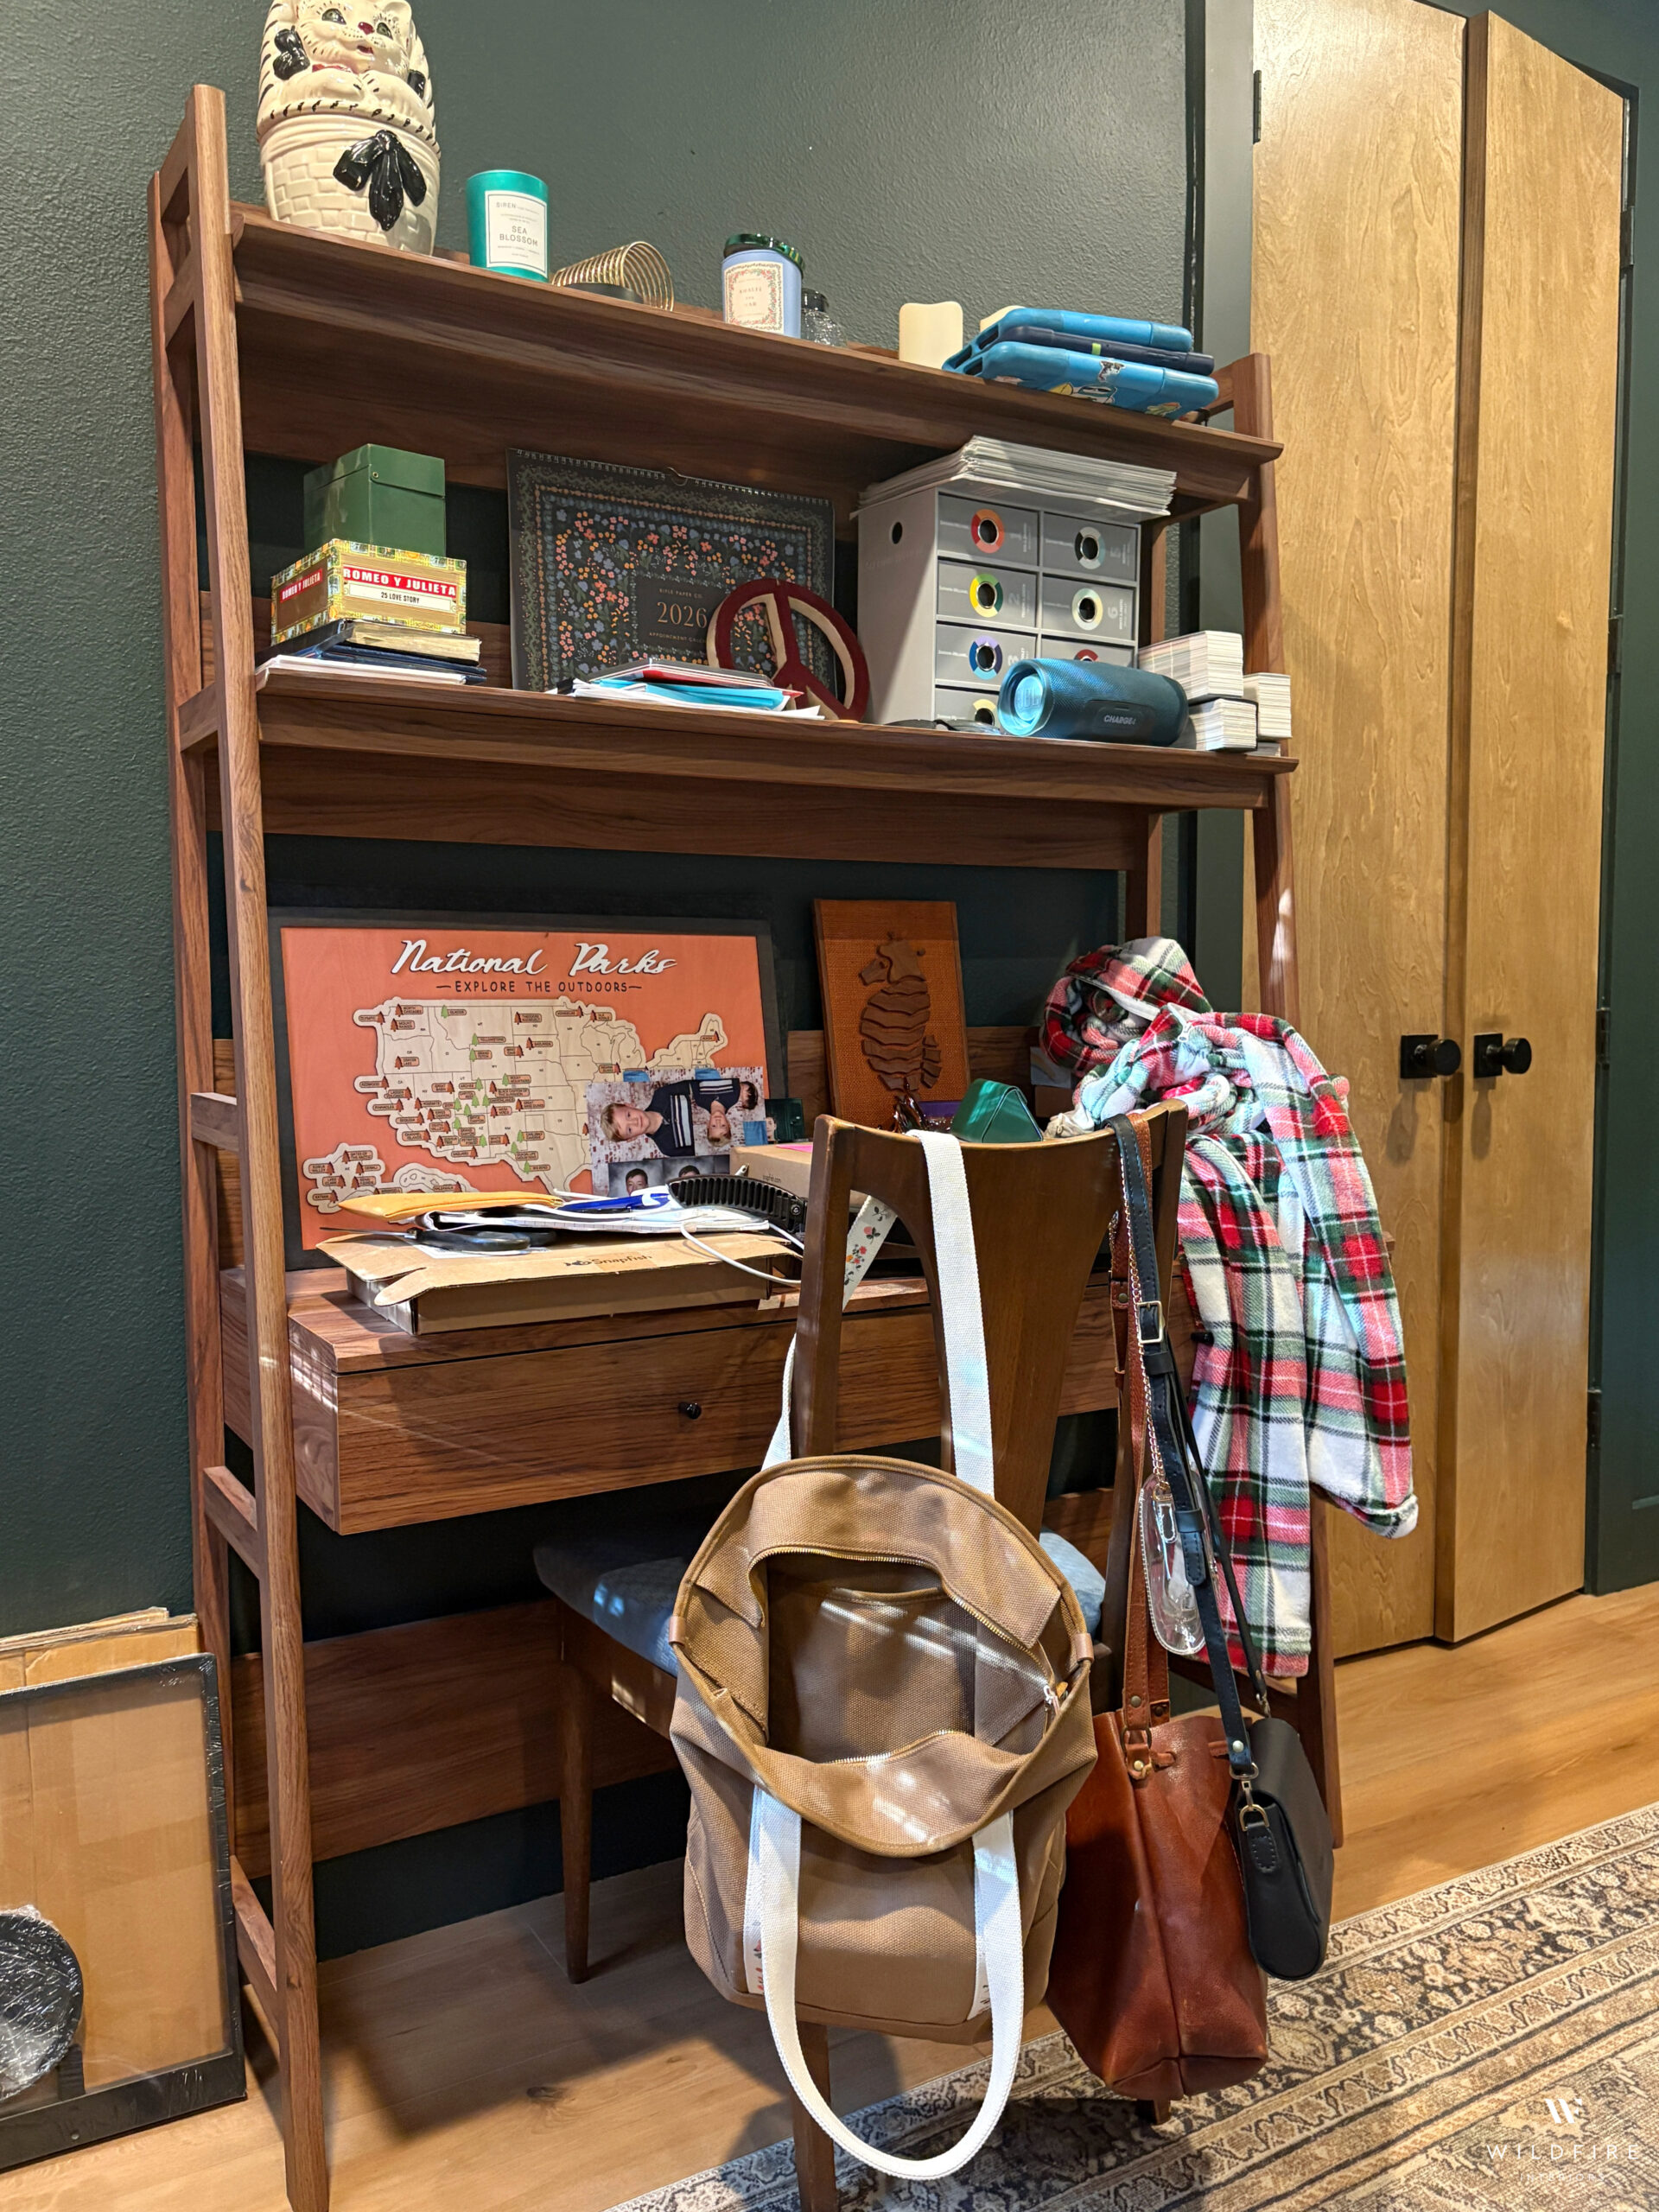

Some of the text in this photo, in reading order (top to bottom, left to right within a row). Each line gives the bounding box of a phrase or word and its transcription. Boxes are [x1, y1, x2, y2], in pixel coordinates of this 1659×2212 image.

[512, 226, 527, 235] SEA
[499, 233, 538, 246] BLOSSOM
[282, 572, 321, 601] ROMEO Y JULIETA
[344, 569, 456, 596] ROMEO Y JULIETA
[389, 593, 403, 601] LOVE
[404, 594, 420, 604] STORY
[657, 601, 708, 629] 2026
[1108, 606, 1118, 620] 6
[391, 939, 677, 977] National Parks
[454, 981, 627, 993] EXPLORE THE OUTDOORS
[591, 1255, 653, 1265] Snapfish
